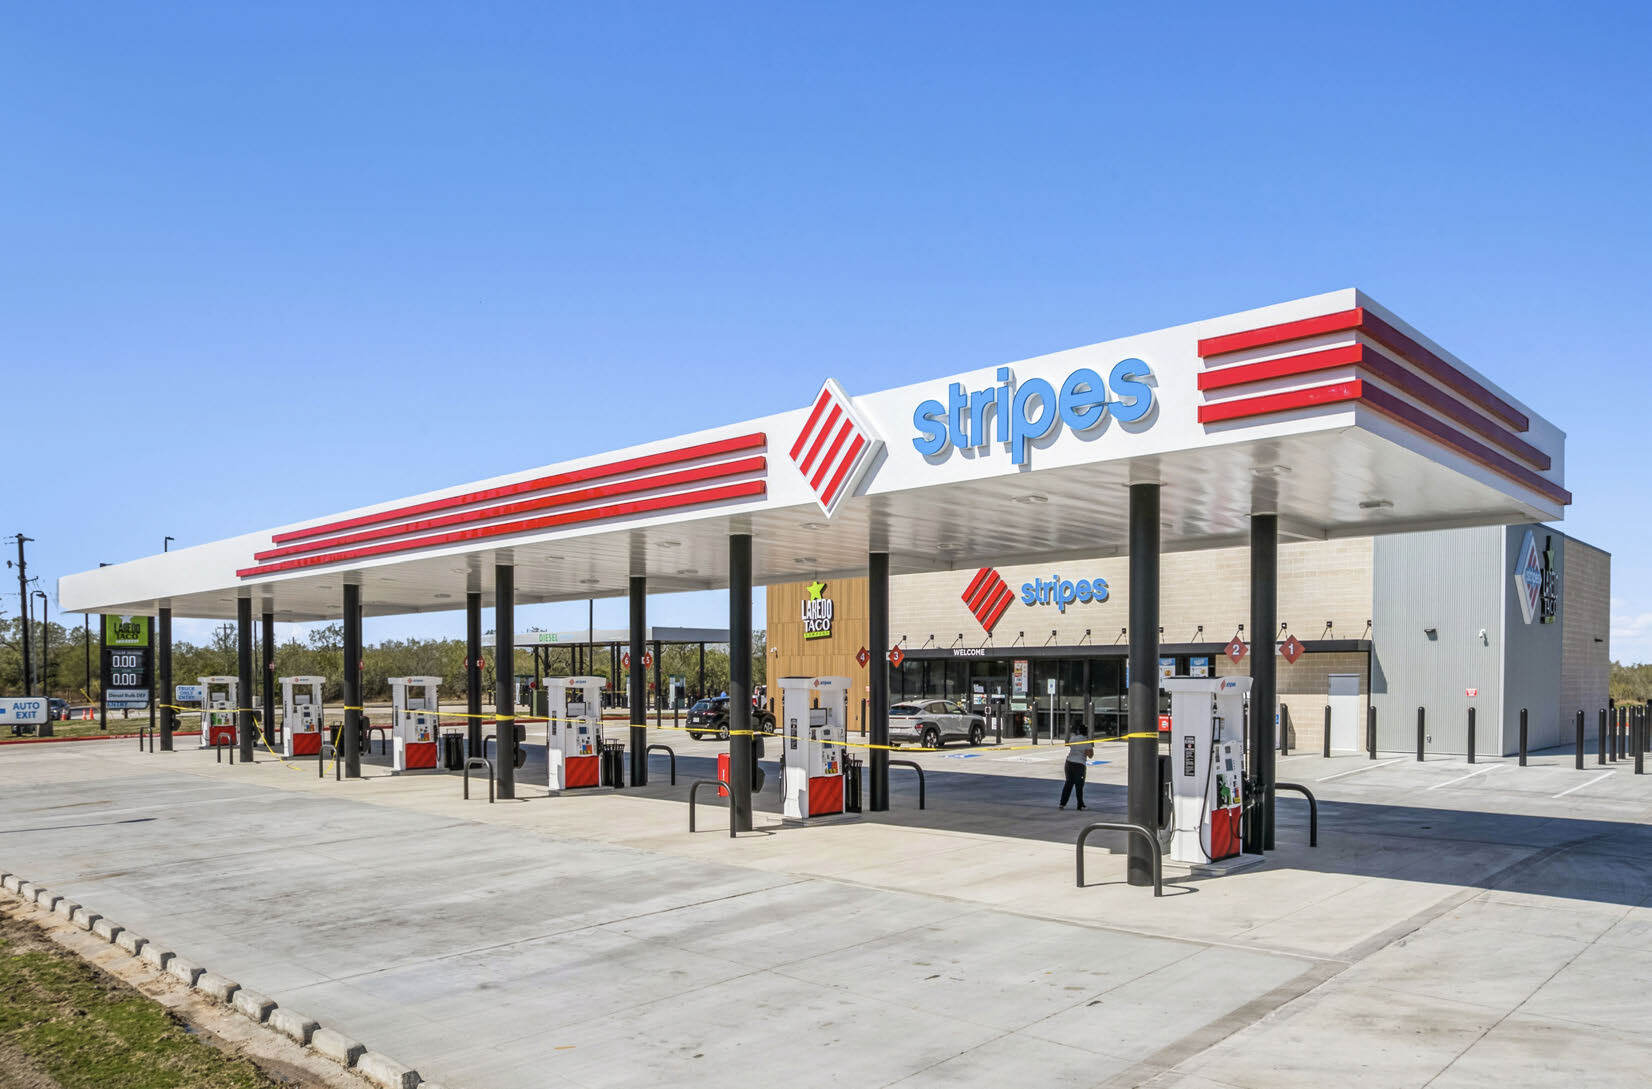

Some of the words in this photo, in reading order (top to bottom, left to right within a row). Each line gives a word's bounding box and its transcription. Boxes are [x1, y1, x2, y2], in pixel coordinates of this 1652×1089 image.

[912, 358, 1152, 464] stripes
[1021, 574, 1108, 611] stripes
[801, 598, 832, 620] LAREDO
[804, 619, 830, 632] TACO
[538, 633, 558, 642] DIESEL
[1232, 644, 1240, 656] 2
[1288, 643, 1294, 655] 1
[112, 655, 136, 668] 0.00
[860, 652, 866, 662] 4
[893, 651, 900, 661] 3
[112, 673, 136, 686] 0.00
[13, 701, 40, 711] AUTO
[16, 711, 37, 720] EXIT
